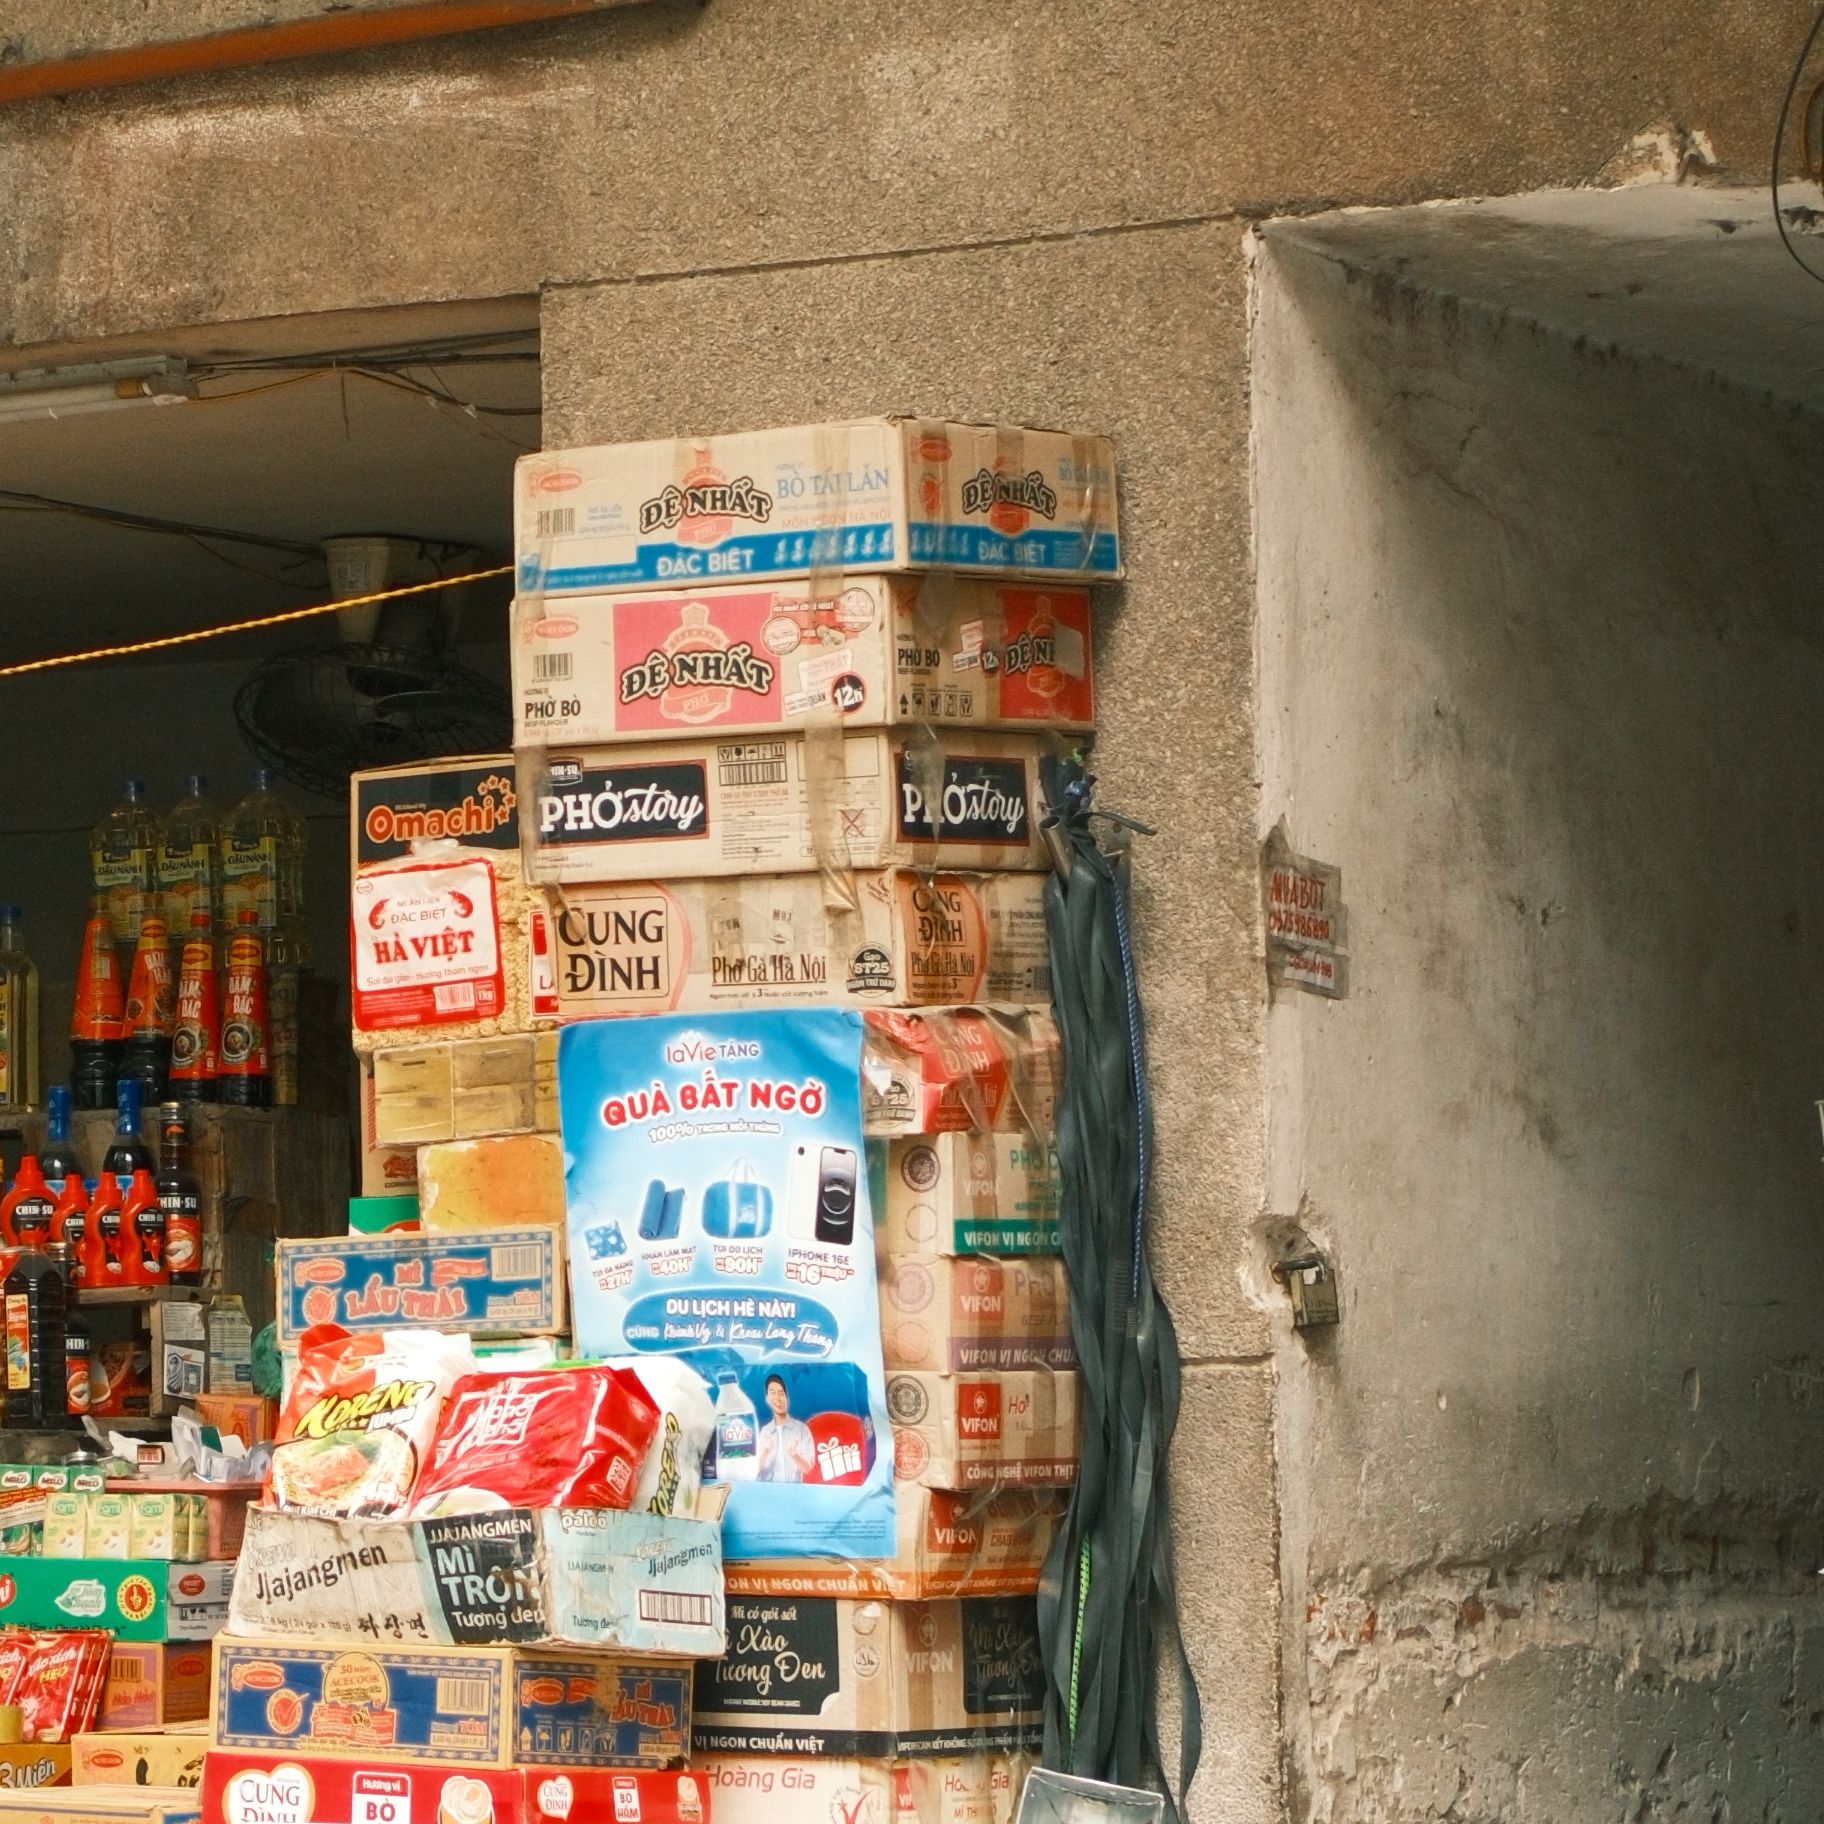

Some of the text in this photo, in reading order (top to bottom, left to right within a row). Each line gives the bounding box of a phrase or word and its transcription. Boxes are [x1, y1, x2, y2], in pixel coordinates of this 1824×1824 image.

[776, 477, 805, 500] BÒ
[962, 468, 1056, 519] ĐỆ NHẤT
[639, 475, 773, 533] ĐỆ NHẤT
[658, 548, 754, 579] ĐẶC BIỆT
[621, 641, 774, 703] ĐỆ NHẤT
[526, 694, 581, 719] PHỞ BÒ
[367, 799, 496, 844] Omachi
[391, 908, 447, 924] ĐẶC BIỆT
[559, 906, 666, 947] CUNG
[373, 926, 474, 963] HÀ VIỆT
[566, 950, 661, 994] ĐÌNH
[667, 1042, 759, 1064] laVie TẶNG
[603, 1069, 824, 1127] QUÀ BẤT NGỜ
[649, 1124, 694, 1143] 100%
[667, 1297, 795, 1319] DU LỊCH HÈ NÀY!
[962, 1416, 998, 1434] VIFON
[430, 1518, 532, 1543] JJAJANGMEN
[775, 1650, 826, 1682] Đen
[711, 1735, 824, 1753] NGON VIỆT
[240, 1778, 300, 1806] CUNG
